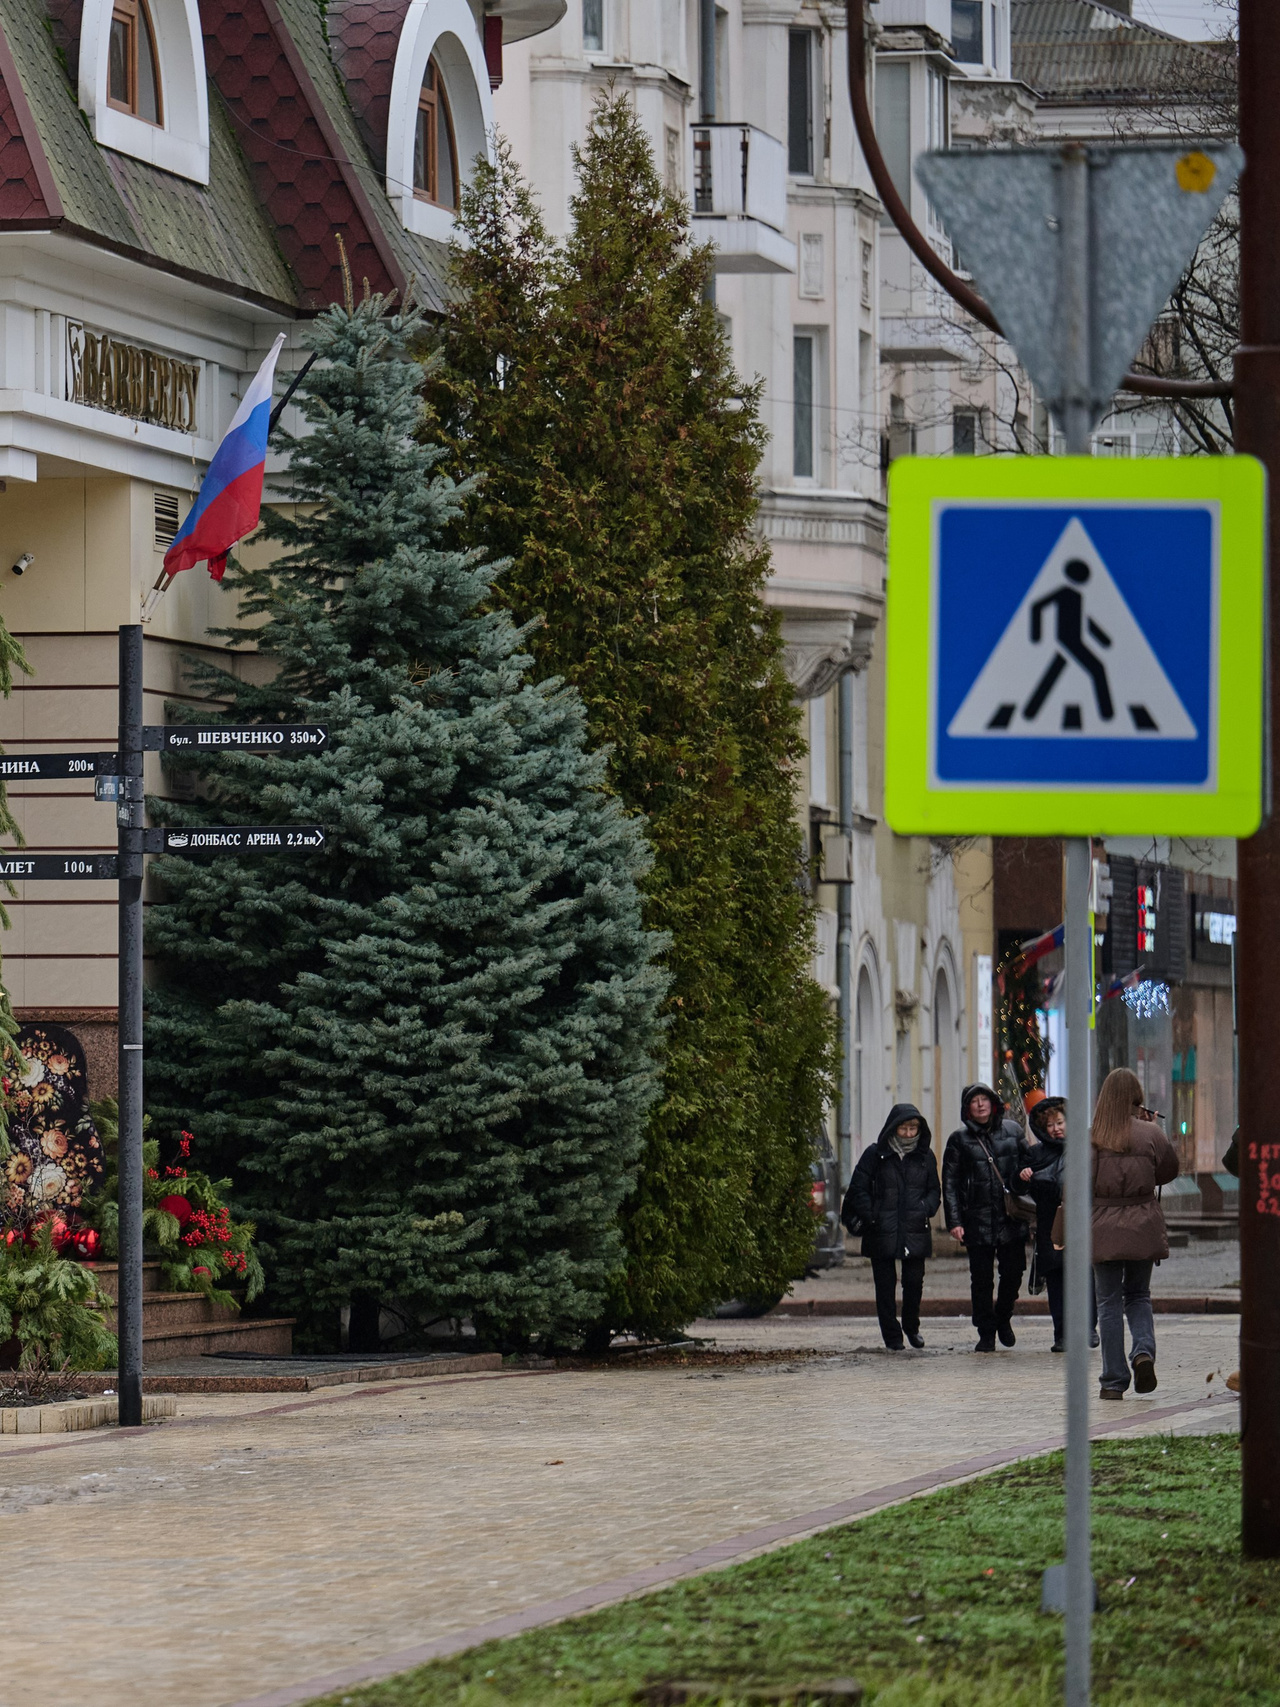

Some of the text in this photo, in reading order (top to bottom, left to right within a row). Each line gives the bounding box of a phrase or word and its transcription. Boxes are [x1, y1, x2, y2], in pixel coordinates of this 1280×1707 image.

[83, 330, 201, 432] BARBERRY
[169, 731, 317, 747] бул. ШЕВЧЕНКО 350м
[68, 759, 94, 772] 200м
[190, 832, 316, 847] ДОНБАСС АРЕНА 2,2км
[64, 861, 93, 874] 100м
